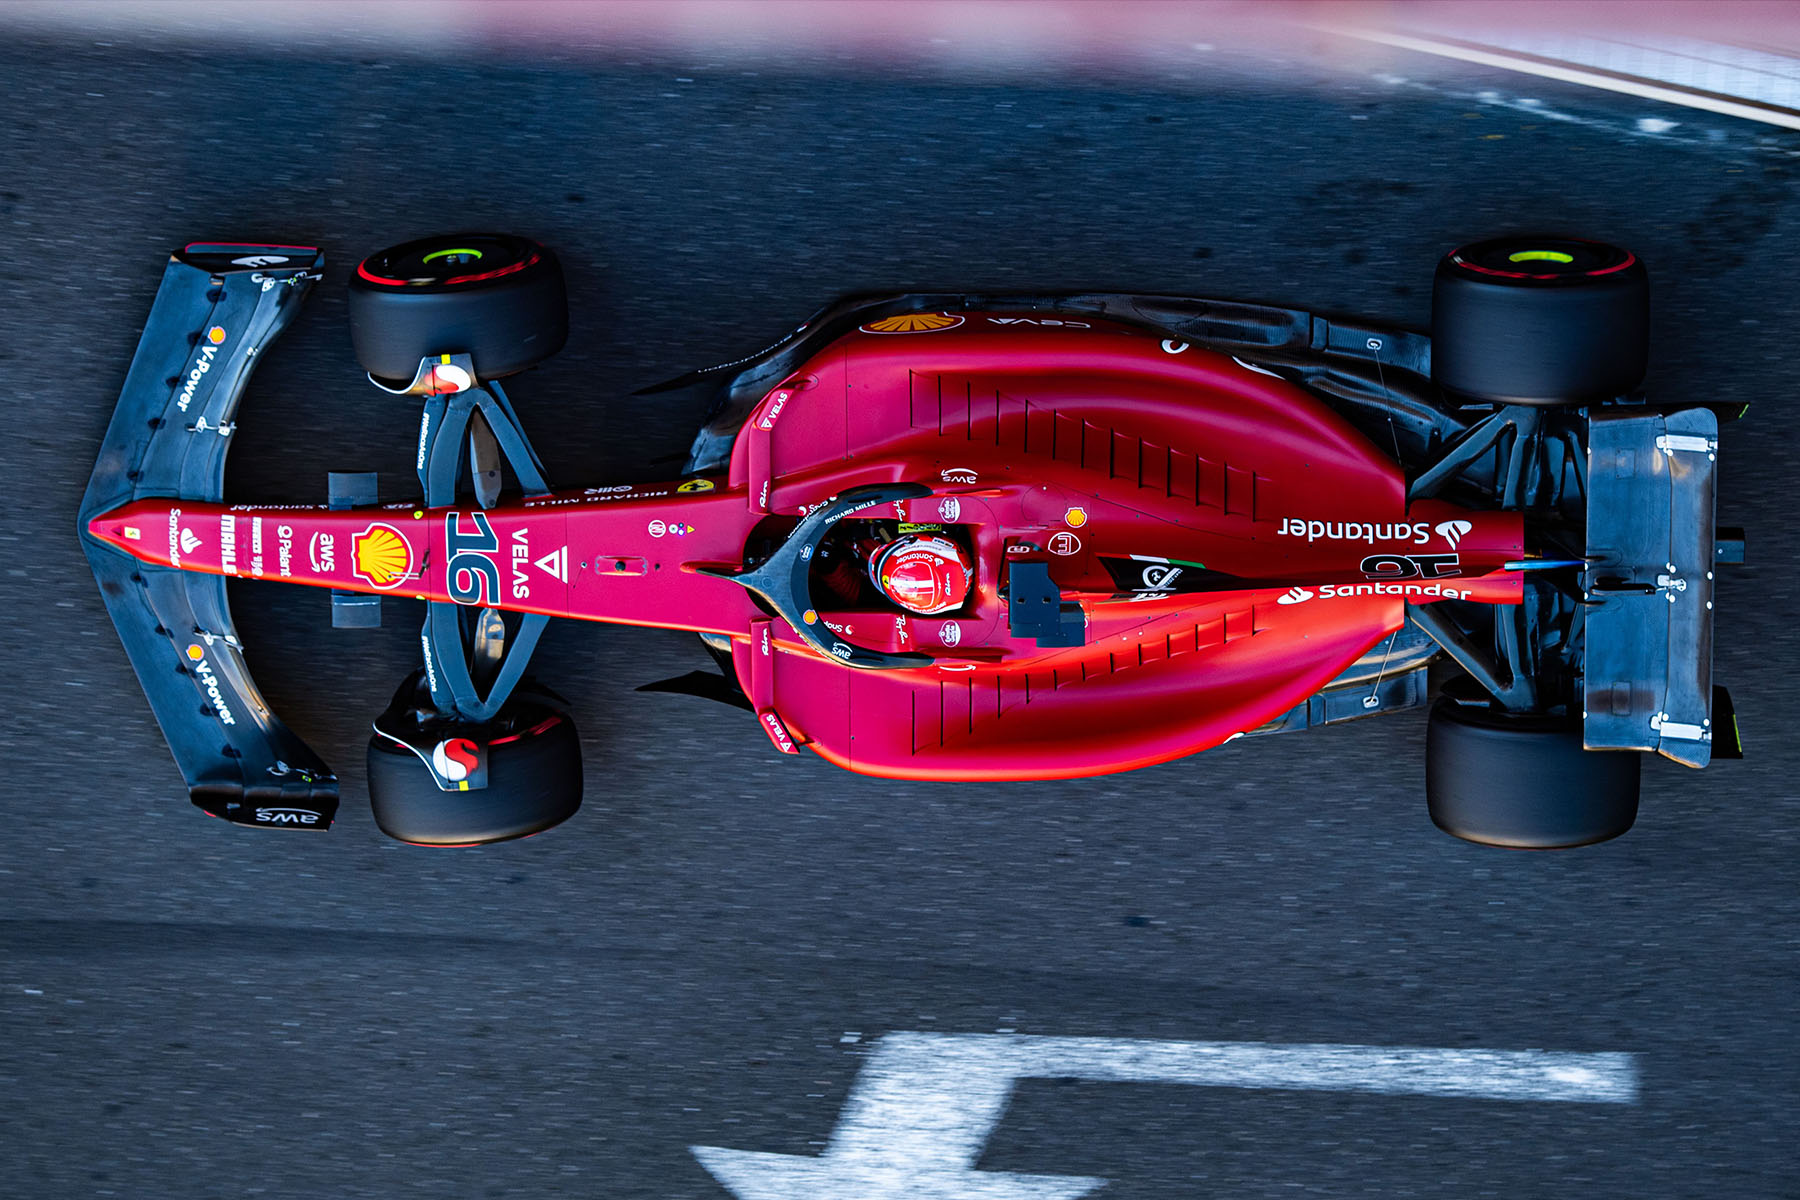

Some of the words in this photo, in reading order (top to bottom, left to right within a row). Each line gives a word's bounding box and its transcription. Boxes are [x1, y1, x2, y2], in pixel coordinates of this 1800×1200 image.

[177, 346, 218, 412] V-Power
[768, 391, 789, 420] VELAS
[943, 476, 976, 484] aws
[525, 498, 579, 506] MILLE
[587, 492, 668, 502] RICHARD
[824, 507, 856, 525] RICHARD
[855, 499, 877, 512] MILLE
[168, 508, 182, 568] Santander
[220, 514, 237, 575] MAHLE
[1277, 518, 1430, 545] Santander
[320, 533, 335, 573] aws
[445, 512, 501, 606] 16
[512, 528, 529, 598] VELAS
[896, 553, 934, 566] Santander
[1360, 553, 1463, 580] 16
[1318, 582, 1472, 601] Santander
[832, 648, 851, 659] aws
[195, 660, 236, 727] V-Power
[765, 714, 785, 742] VELAS
[255, 811, 320, 825] aws
